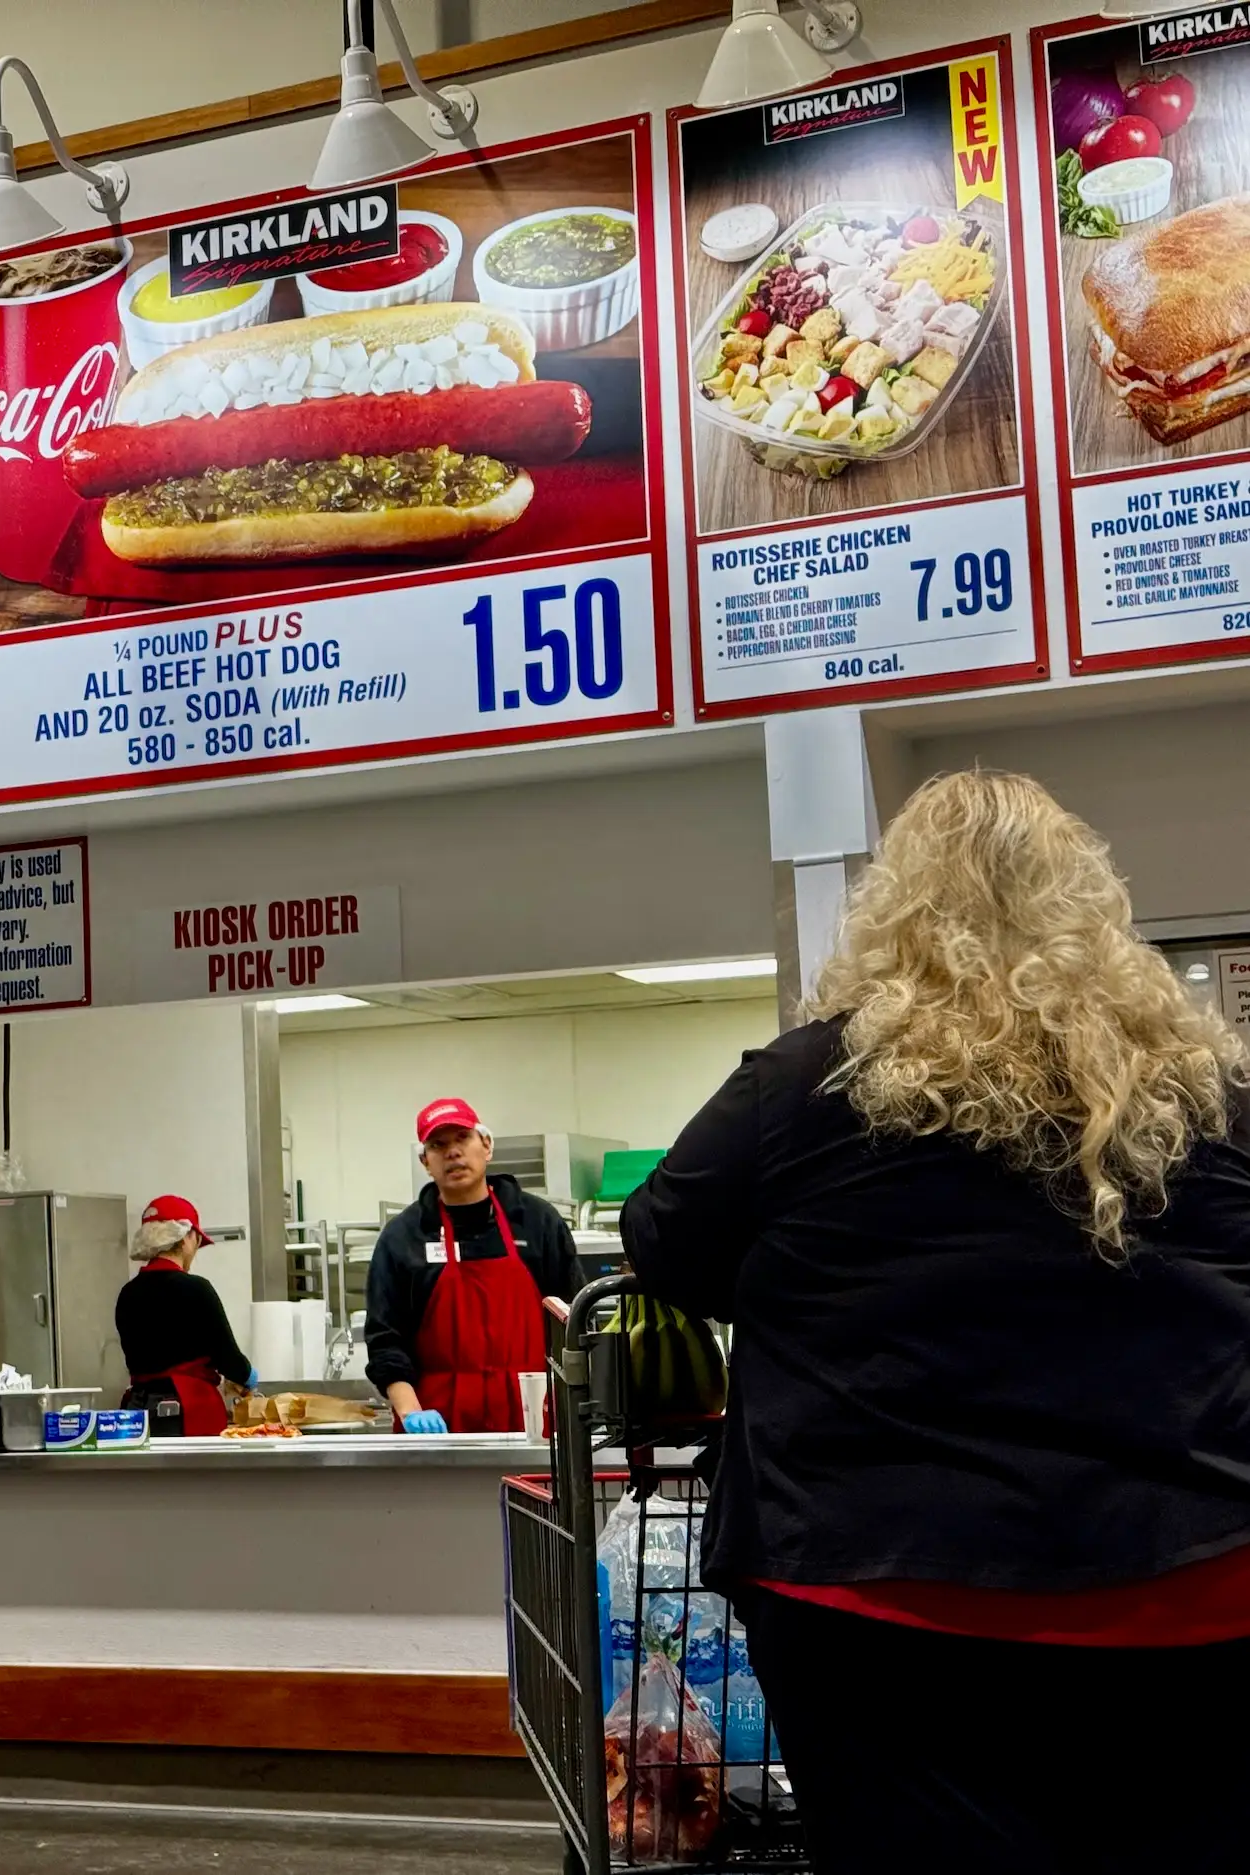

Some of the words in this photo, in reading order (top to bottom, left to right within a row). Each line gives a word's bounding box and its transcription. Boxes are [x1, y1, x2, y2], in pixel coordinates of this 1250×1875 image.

[1148, 5, 1250, 45] KIRKLA
[771, 82, 898, 126] KIRKLAND
[771, 105, 899, 139] Signature
[957, 67, 997, 187] NEW
[181, 195, 388, 267] KIRKLAND
[182, 240, 390, 293] Signature
[1127, 491, 1162, 513] HOT
[1168, 479, 1240, 507] TURKEY
[1091, 507, 1199, 539] PROVOLONE
[712, 537, 822, 571] ROTISSERIE
[826, 524, 911, 554] CHICKEN
[1113, 544, 1137, 560] OVEN
[1139, 538, 1180, 557] ROASTED
[1182, 533, 1216, 550] TURKEY
[754, 565, 802, 586] CHEF
[805, 552, 869, 579] SALAD
[1114, 556, 1167, 577] PROVOLONE
[1168, 552, 1202, 569] CHEESE
[1115, 577, 1133, 593] RED
[1135, 572, 1170, 589] ONIONS
[1172, 570, 1179, 585] &
[1182, 564, 1231, 583] TOMATOES
[725, 589, 771, 610] ROTISSERIE
[773, 585, 809, 604] CHICKEN
[910, 547, 1013, 622] 7.99
[1116, 593, 1143, 609] BASIL
[1145, 588, 1177, 604] GARLIC
[1179, 579, 1240, 599] MAYONNAISE
[725, 608, 764, 627] ROMAINE
[766, 603, 792, 621] BLEND
[800, 598, 833, 616] CHERRY
[834, 592, 881, 611] TOMATOES
[138, 629, 208, 659] POUND
[215, 611, 303, 649] PLUS
[726, 626, 758, 643] BACON,
[786, 616, 826, 635] CHEDDAR
[826, 612, 858, 630] CHEESE
[727, 640, 781, 660] PEPPERCORN
[782, 637, 812, 653] RANCH
[813, 629, 856, 649] DRESSING
[462, 576, 623, 714] 1.50
[83, 667, 133, 701] ALL
[142, 657, 206, 693] BEEF
[216, 649, 271, 684] HOT
[281, 639, 341, 675] DOG
[825, 657, 863, 680] 840
[868, 653, 905, 674] cal.
[35, 709, 90, 742] AND
[98, 703, 130, 734] 20
[139, 703, 175, 730] oz.
[186, 687, 261, 723] SODA
[271, 680, 332, 718] (With
[338, 672, 407, 704] Refill)
[127, 731, 176, 765] 580
[204, 723, 254, 756] 850
[263, 718, 310, 750] cal.
[10, 854, 23, 879] is
[28, 849, 62, 877] used
[52, 879, 75, 906] but
[174, 904, 258, 949] KIOSK
[267, 894, 359, 941] ORDER
[208, 945, 325, 993] PICK-UP
[1230, 963, 1250, 974] Fo
